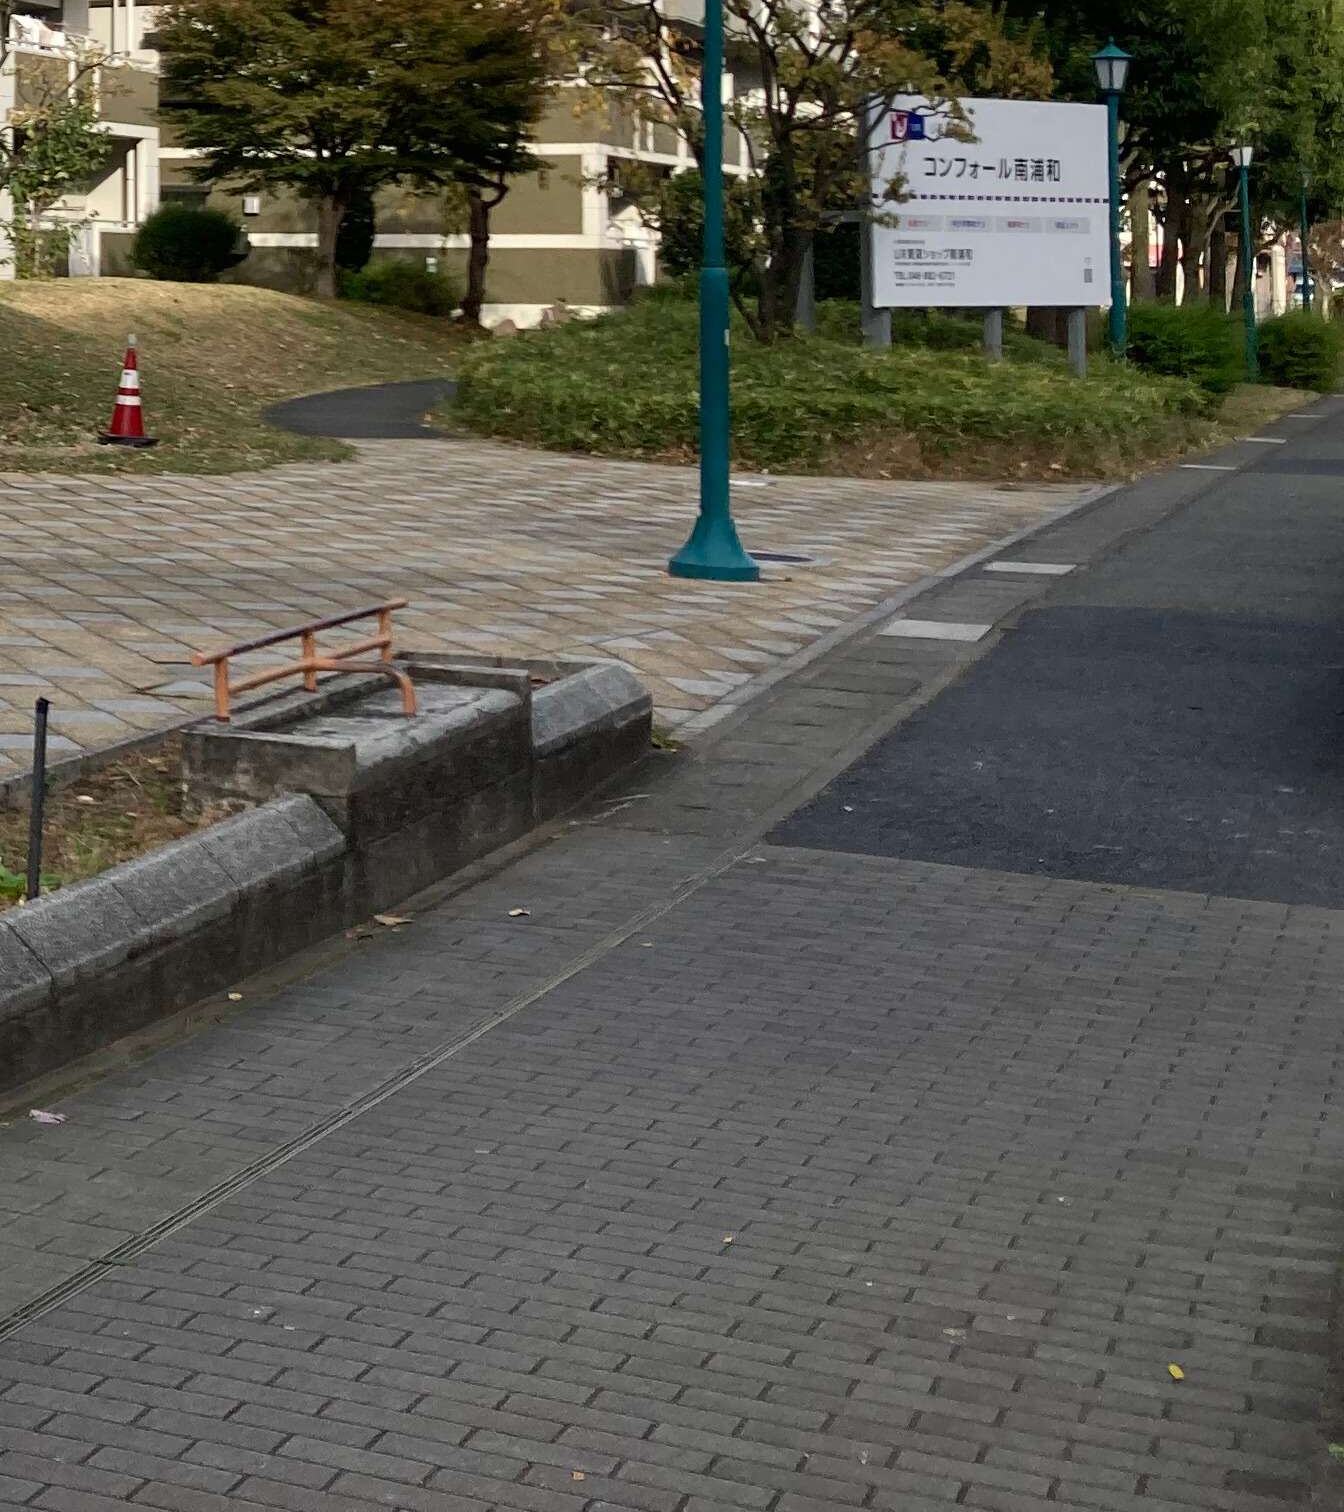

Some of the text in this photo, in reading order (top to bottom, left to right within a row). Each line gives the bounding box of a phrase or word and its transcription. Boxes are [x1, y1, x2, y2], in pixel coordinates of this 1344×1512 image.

[923, 157, 1061, 182] コンフォール南浦和
